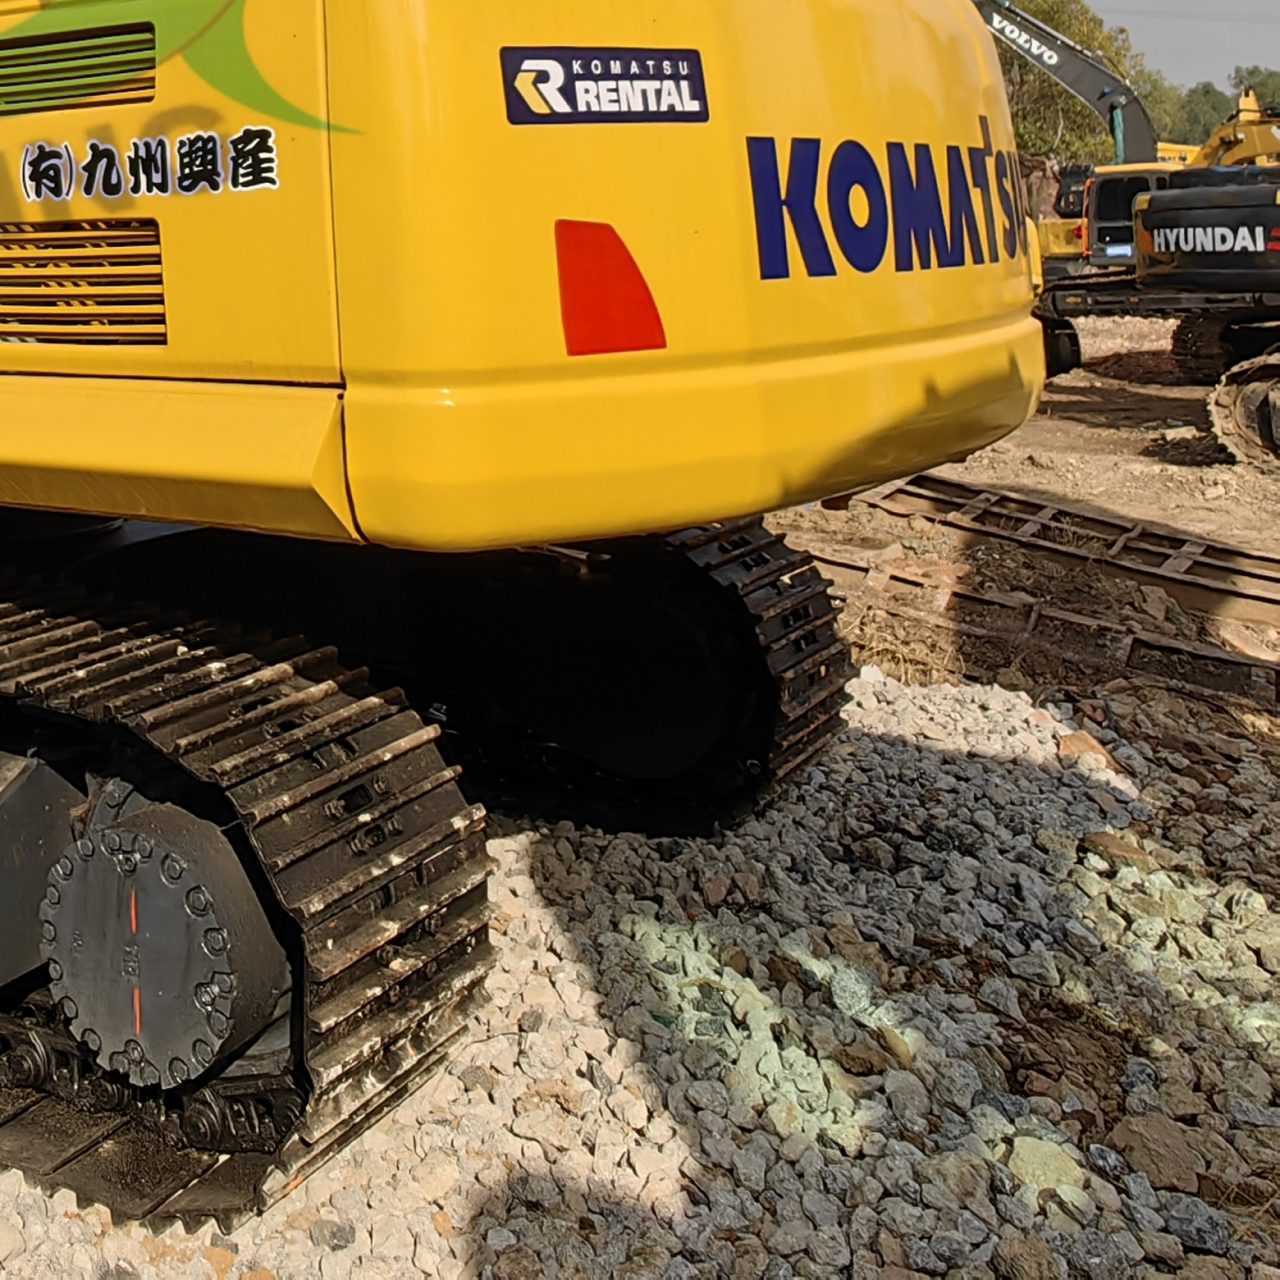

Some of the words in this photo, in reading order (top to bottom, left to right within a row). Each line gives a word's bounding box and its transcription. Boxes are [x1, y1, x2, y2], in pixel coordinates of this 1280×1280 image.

[992, 12, 1058, 65] VOLVO
[572, 60, 689, 75] KOMATSU
[574, 80, 701, 113] RENTAL
[745, 115, 1027, 280] KOMATSU
[1153, 226, 1266, 253] HYUNDAI
